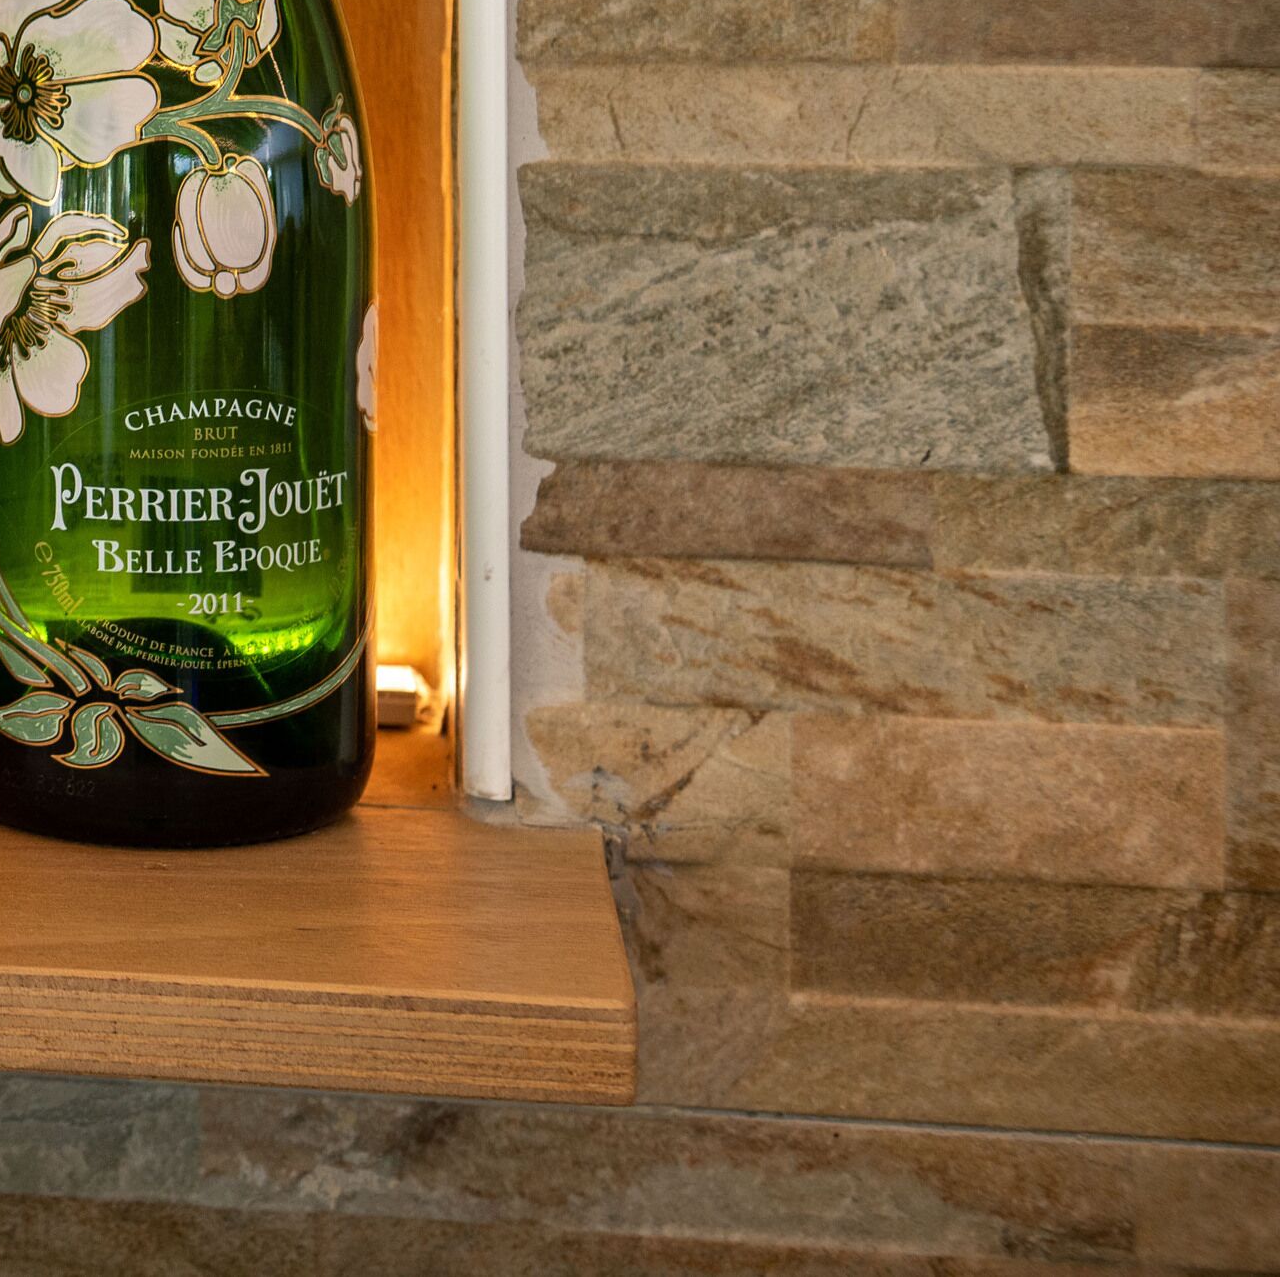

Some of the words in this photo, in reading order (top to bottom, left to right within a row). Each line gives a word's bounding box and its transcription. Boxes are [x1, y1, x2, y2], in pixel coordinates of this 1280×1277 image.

[124, 398, 297, 431] CHAMPAGNE
[129, 448, 185, 459] MAISON
[191, 444, 244, 459] FONDÉE
[249, 445, 265, 456] EN
[270, 442, 292, 454] 1811
[194, 426, 238, 441] BRUT
[50, 462, 347, 534] PERRIER-JOUËT
[92, 539, 203, 574] BELLE
[42, 563, 85, 616] 750ml
[96, 616, 148, 646] PRODUIT
[149, 640, 166, 652] DE
[168, 644, 214, 658] FRANCE
[115, 640, 134, 656] PAR
